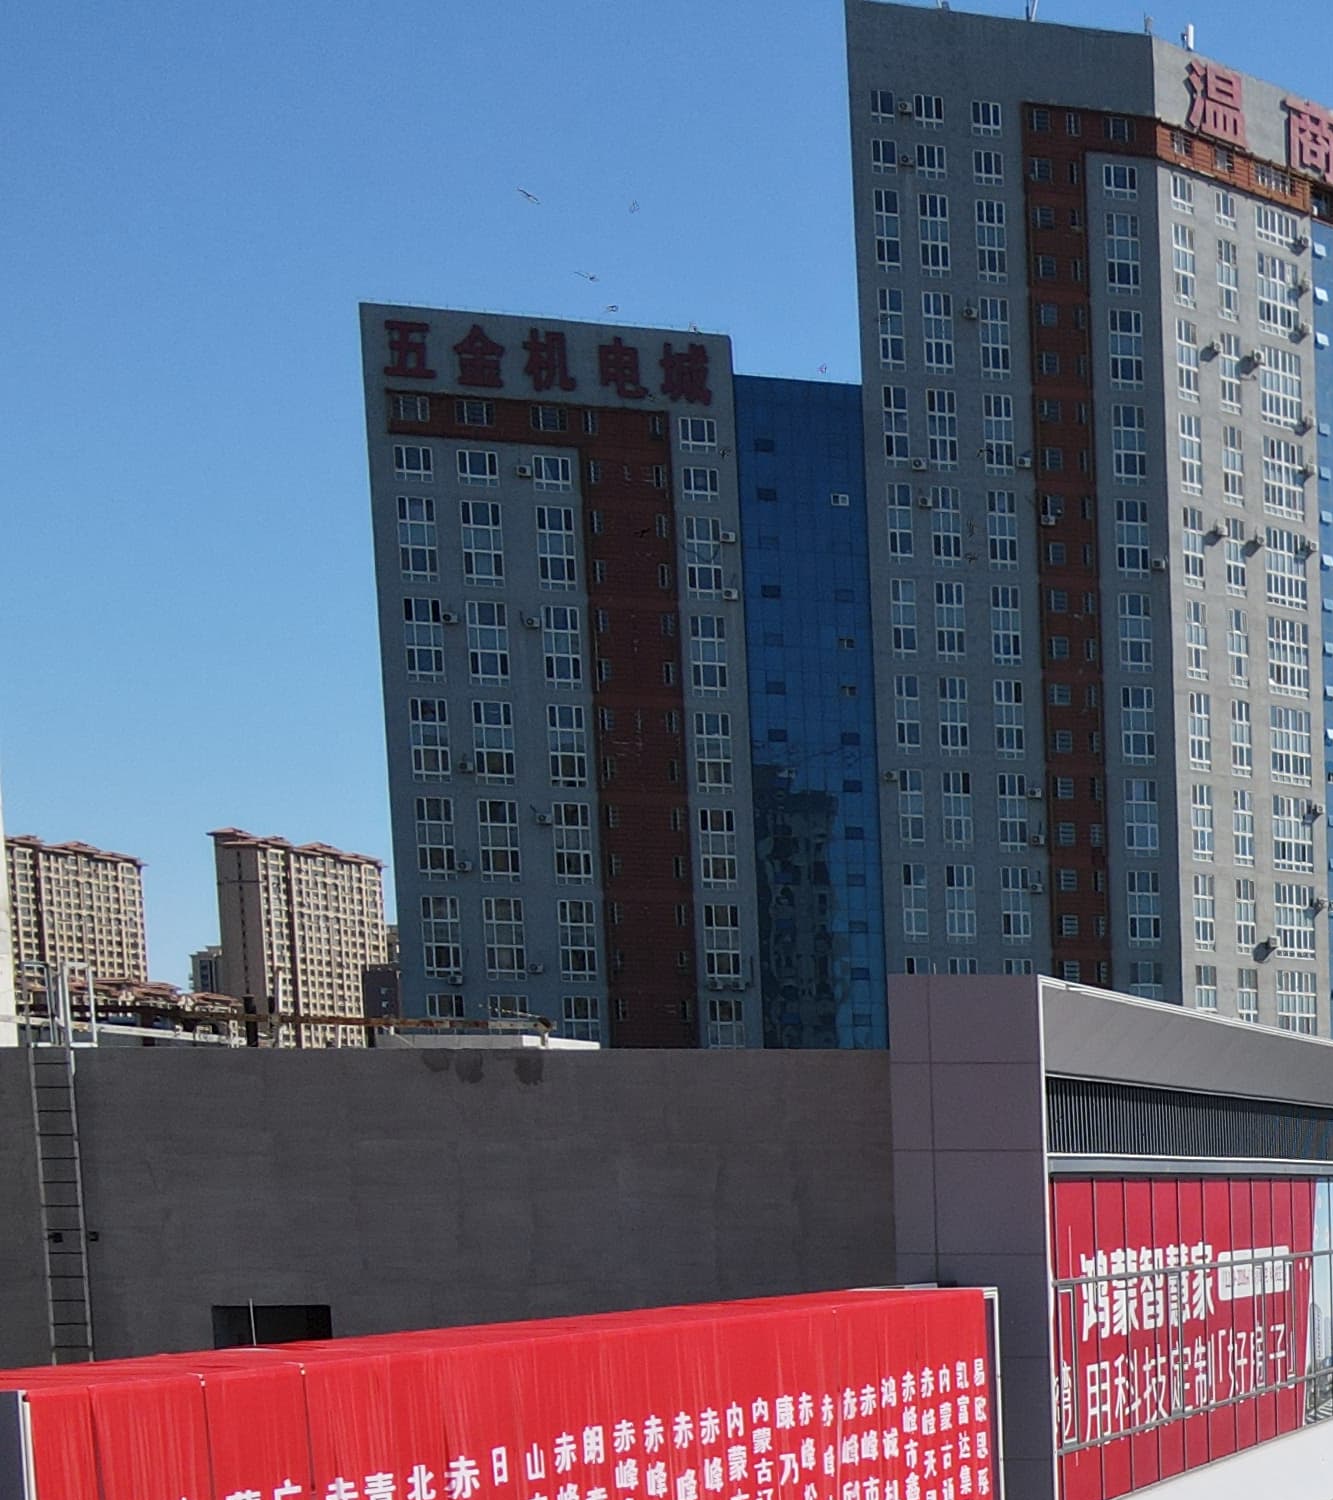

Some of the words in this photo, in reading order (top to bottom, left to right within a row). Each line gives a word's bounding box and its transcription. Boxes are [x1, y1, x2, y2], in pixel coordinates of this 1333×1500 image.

[383, 319, 714, 407] 五金机电城
[1080, 1241, 1214, 1342] 鸿蒙智慧家
